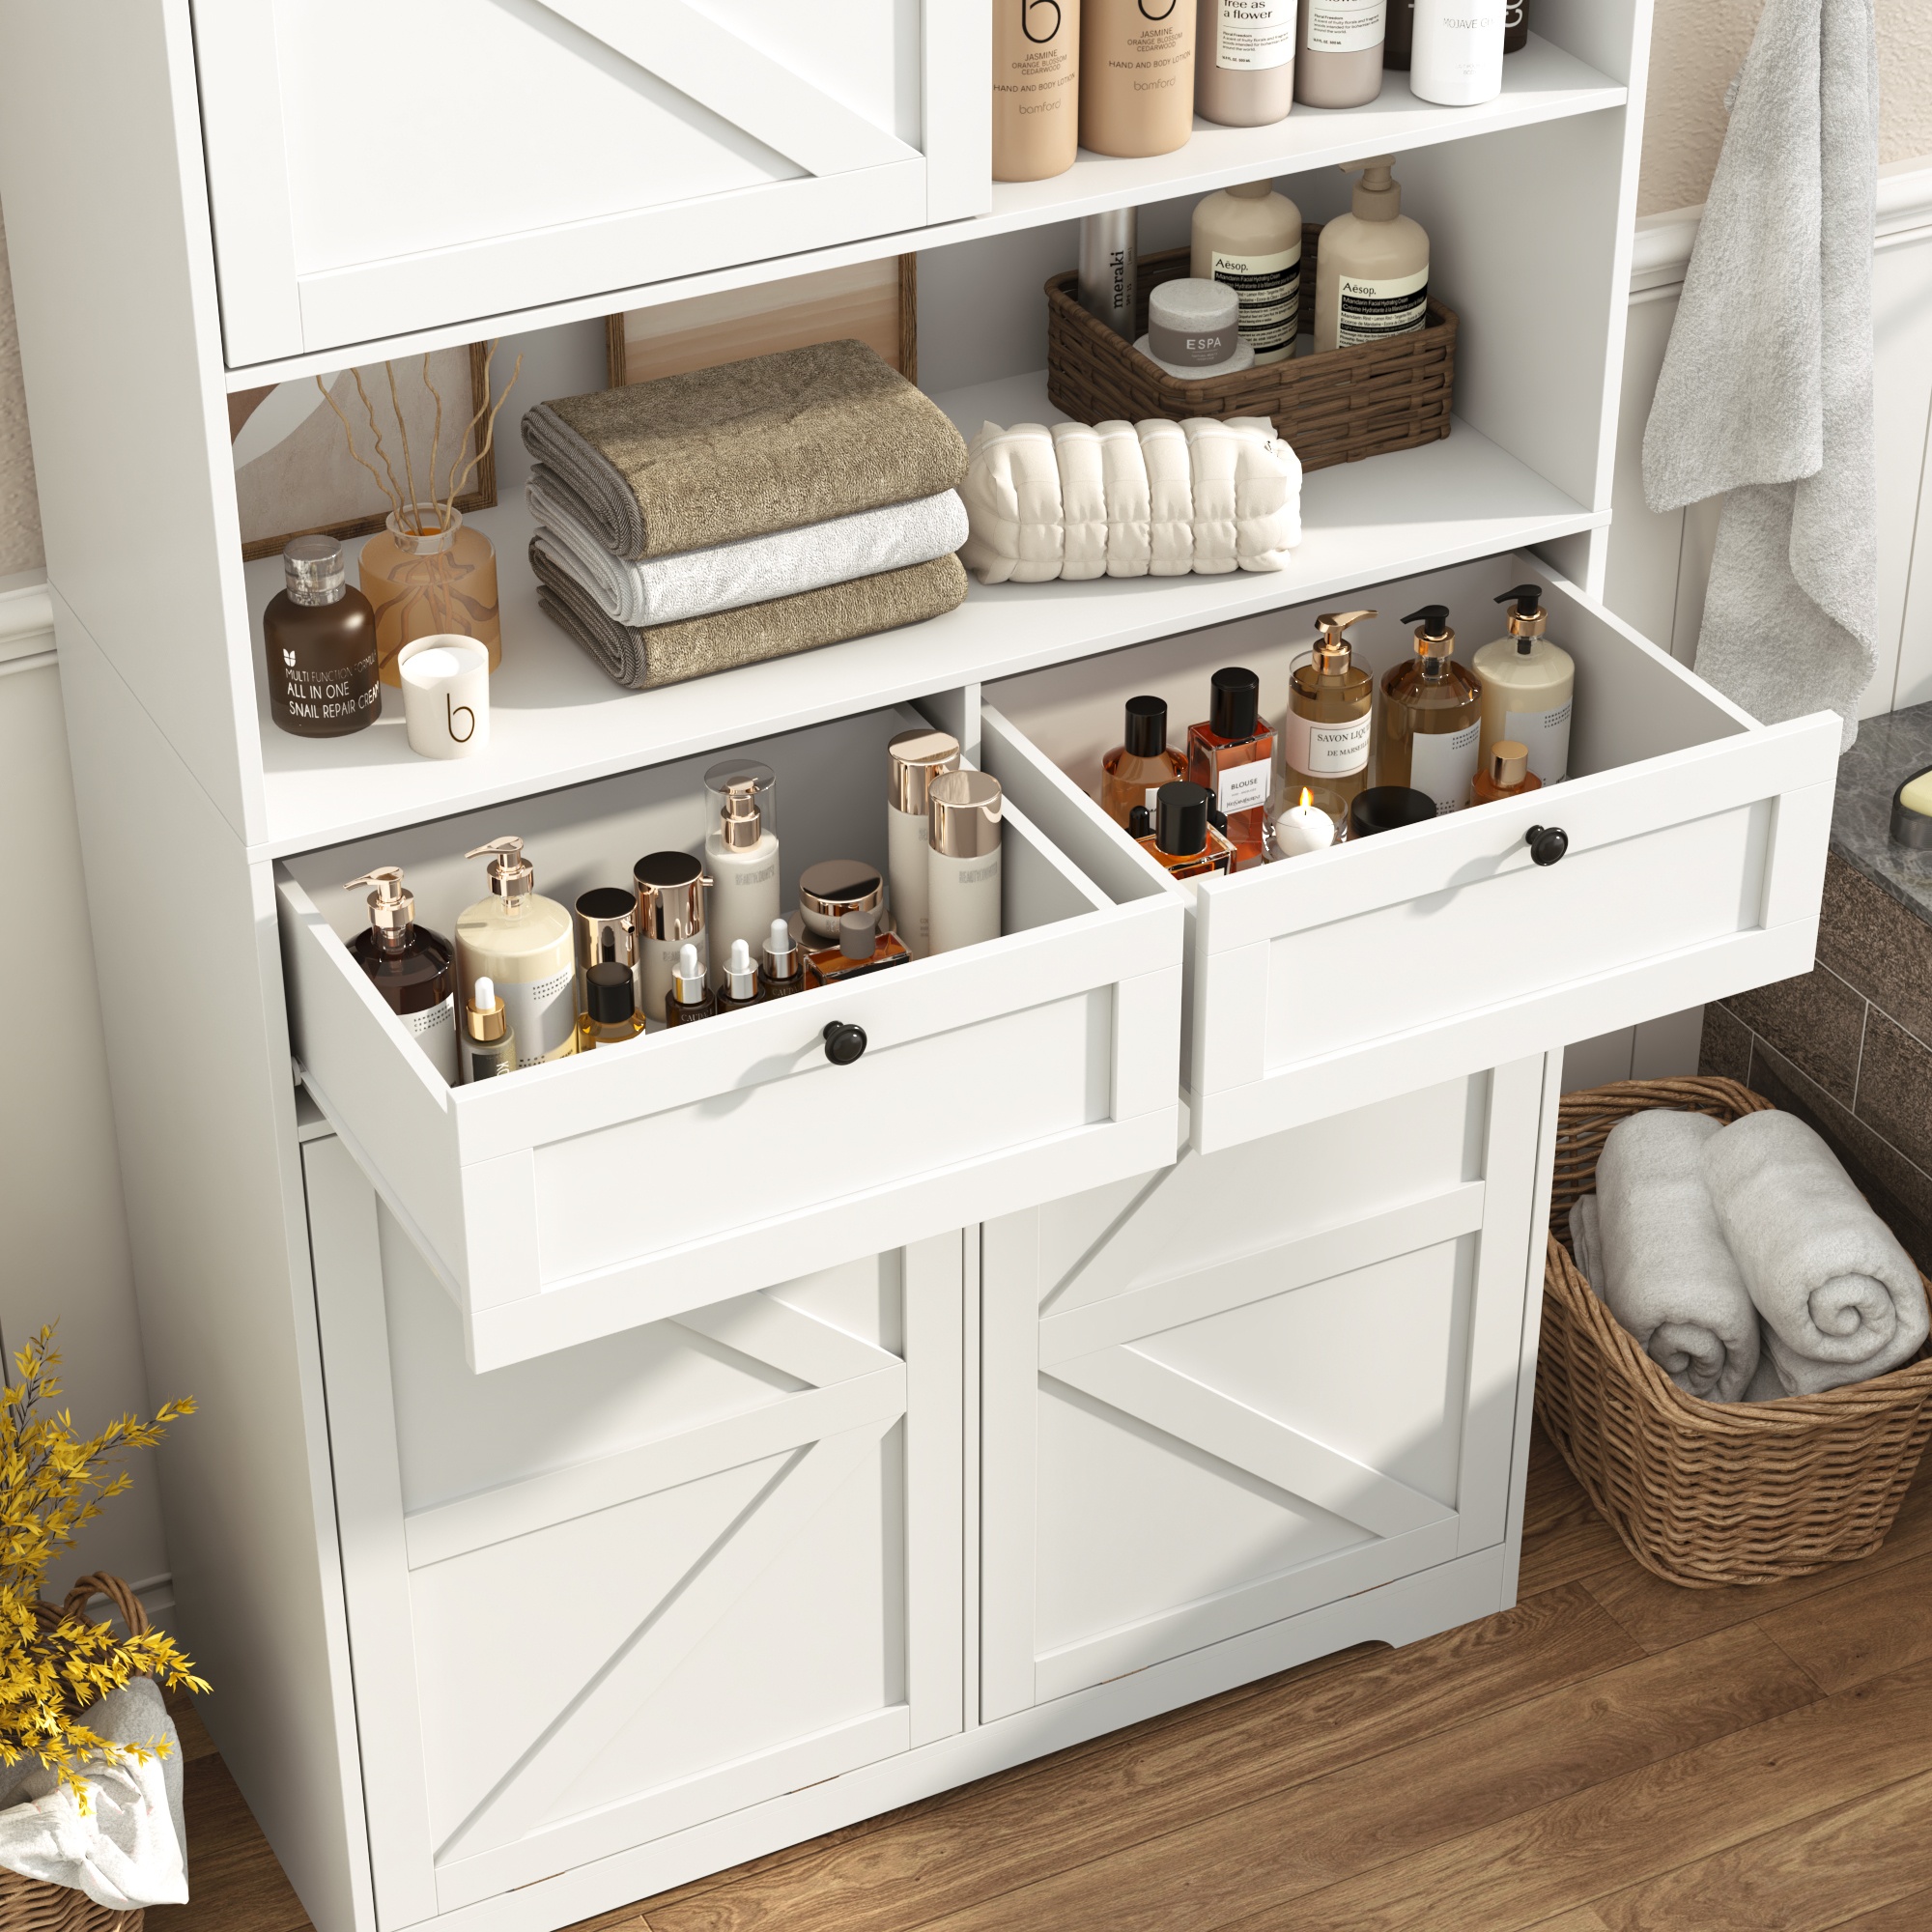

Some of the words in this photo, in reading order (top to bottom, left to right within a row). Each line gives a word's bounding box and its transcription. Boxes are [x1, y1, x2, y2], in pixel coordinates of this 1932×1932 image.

[1234, 10, 1272, 19] flower
[1140, 27, 1173, 39] JASMINE
[1156, 32, 1183, 44] BLOSSOM
[1136, 42, 1177, 52] CEDARWOOD
[1025, 49, 1058, 62] JASMINE
[1041, 54, 1067, 67] BLOSSOM
[1108, 60, 1133, 69] HAND
[1153, 58, 1171, 68] BODY
[1172, 50, 1191, 64] LOTION
[1021, 64, 1061, 75] CEDARWOOD
[993, 84, 1019, 93] HAND
[1020, 84, 1037, 93] AND
[1038, 81, 1056, 91] BODY
[1057, 71, 1075, 87] LOTION
[1133, 75, 1177, 91] bamford
[1019, 98, 1062, 115] bamford
[1109, 250, 1124, 309] meraki
[1186, 336, 1222, 350] ESPA
[285, 668, 309, 682] MULTI
[311, 667, 353, 682] FUNCTION
[287, 681, 306, 698] ALL
[309, 685, 322, 699] IN
[326, 681, 350, 698] ONE
[289, 700, 319, 719] SNAIL
[323, 699, 355, 719] REPAIR
[357, 680, 380, 709] CREAM
[446, 693, 475, 743] b
[1317, 733, 1349, 743] SAVON
[1231, 778, 1258, 790] BLOUSE
